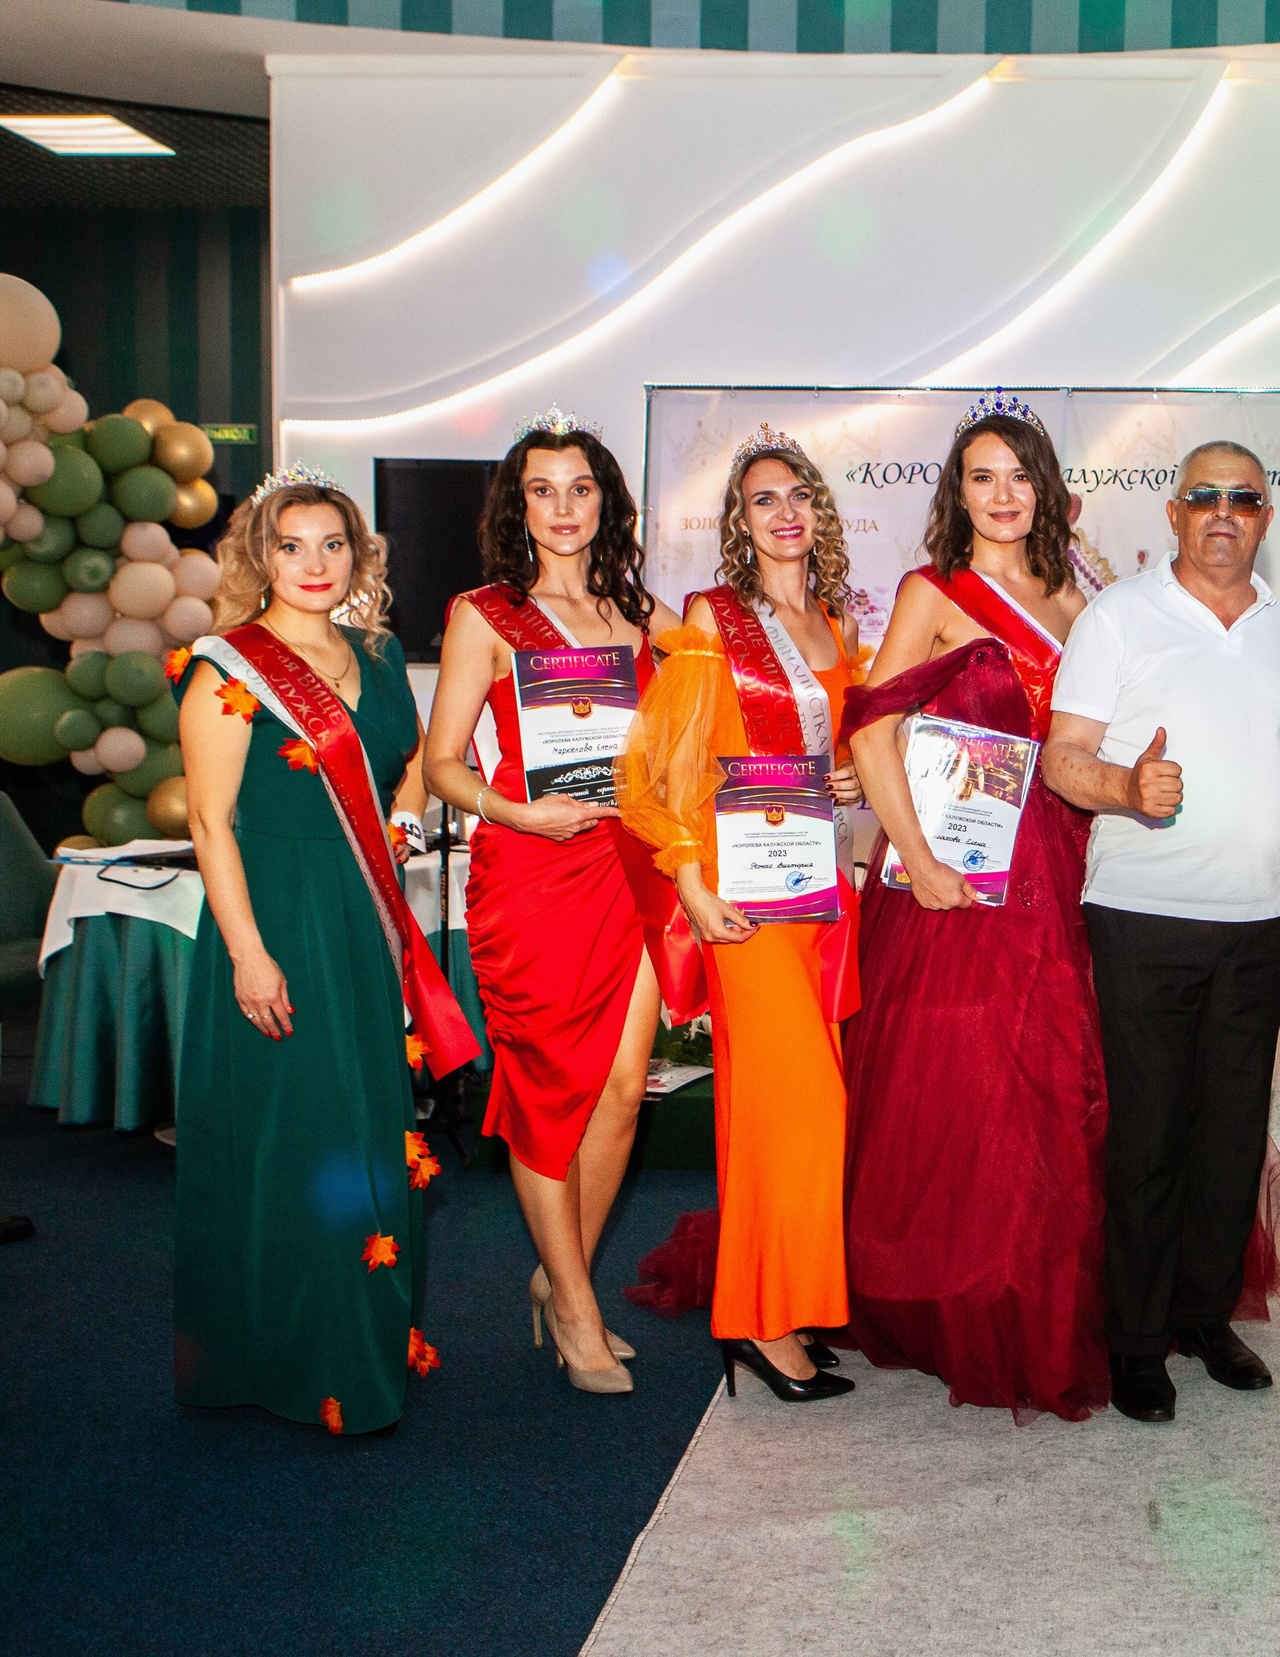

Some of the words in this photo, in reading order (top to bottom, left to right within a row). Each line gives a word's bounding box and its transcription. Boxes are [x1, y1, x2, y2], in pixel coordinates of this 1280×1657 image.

[845, 462, 942, 489] «КОРО
[530, 652, 620, 671] CERTIFICATE
[296, 672, 346, 726] ВИЦЕ
[728, 761, 816, 777] CERTIFICATE
[948, 823, 967, 832] 2023
